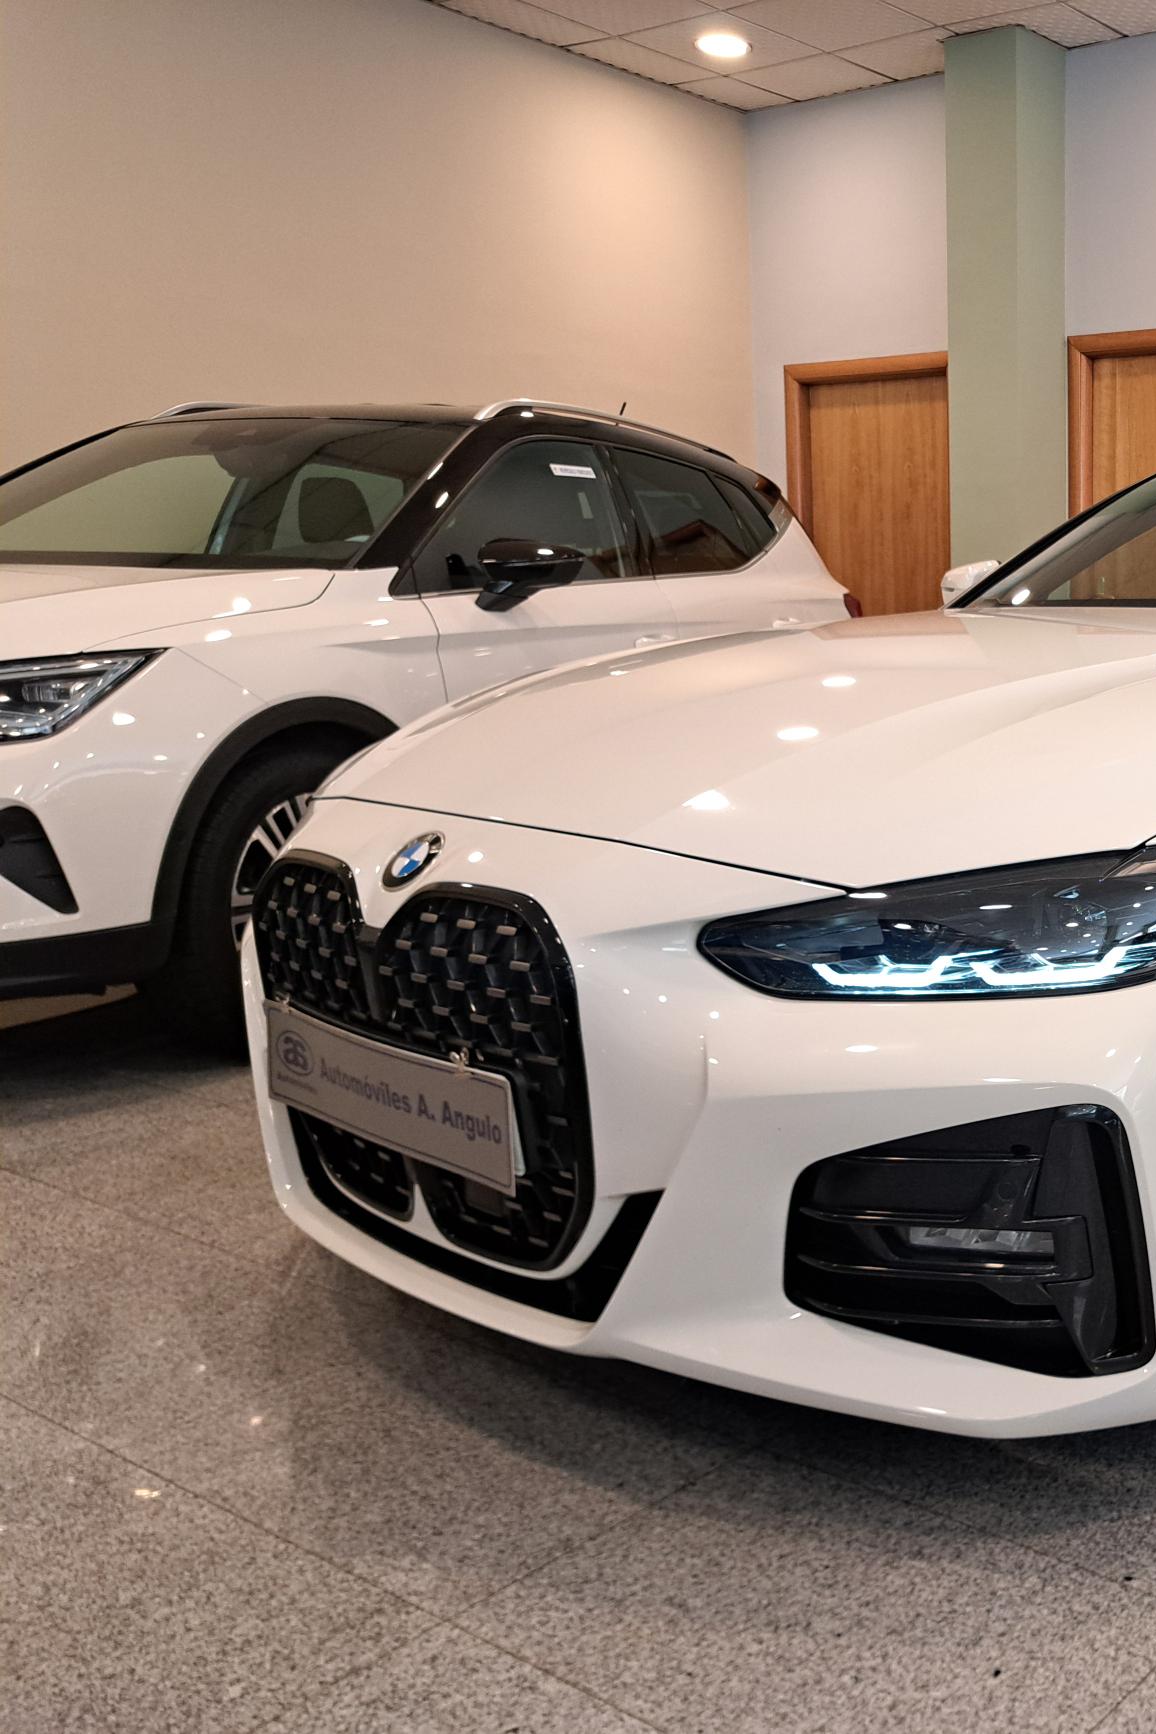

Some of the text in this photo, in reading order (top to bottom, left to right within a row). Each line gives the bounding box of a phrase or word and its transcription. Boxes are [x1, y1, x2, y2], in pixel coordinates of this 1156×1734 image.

[320, 1057, 412, 1114] Automóviles
[417, 1093, 435, 1121] A.
[441, 1101, 502, 1145] Angulo
